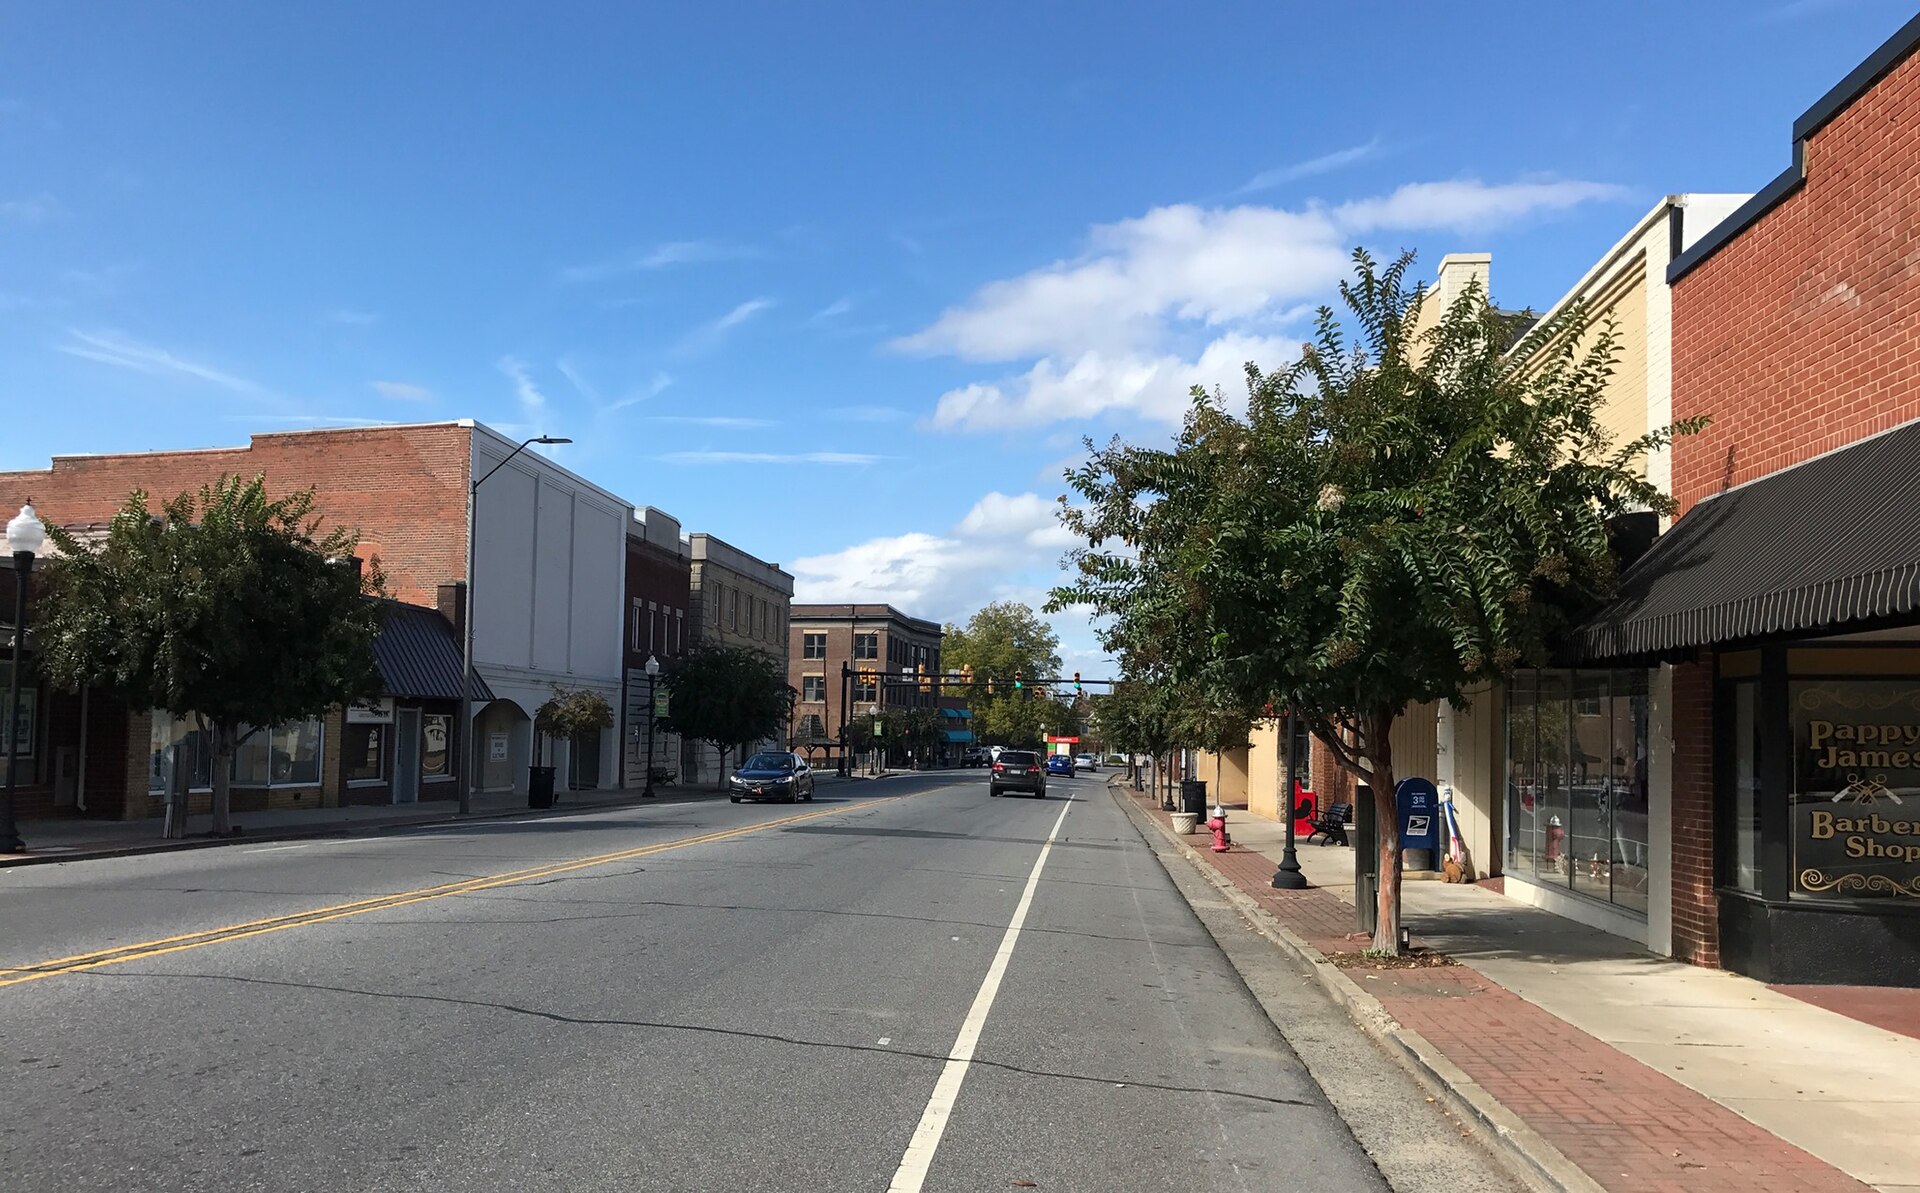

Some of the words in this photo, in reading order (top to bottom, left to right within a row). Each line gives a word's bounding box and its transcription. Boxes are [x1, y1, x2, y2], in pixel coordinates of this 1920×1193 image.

[1809, 720, 1920, 750] Pappy
[1412, 796, 1418, 804] 3
[1846, 835, 1920, 863] Shop
